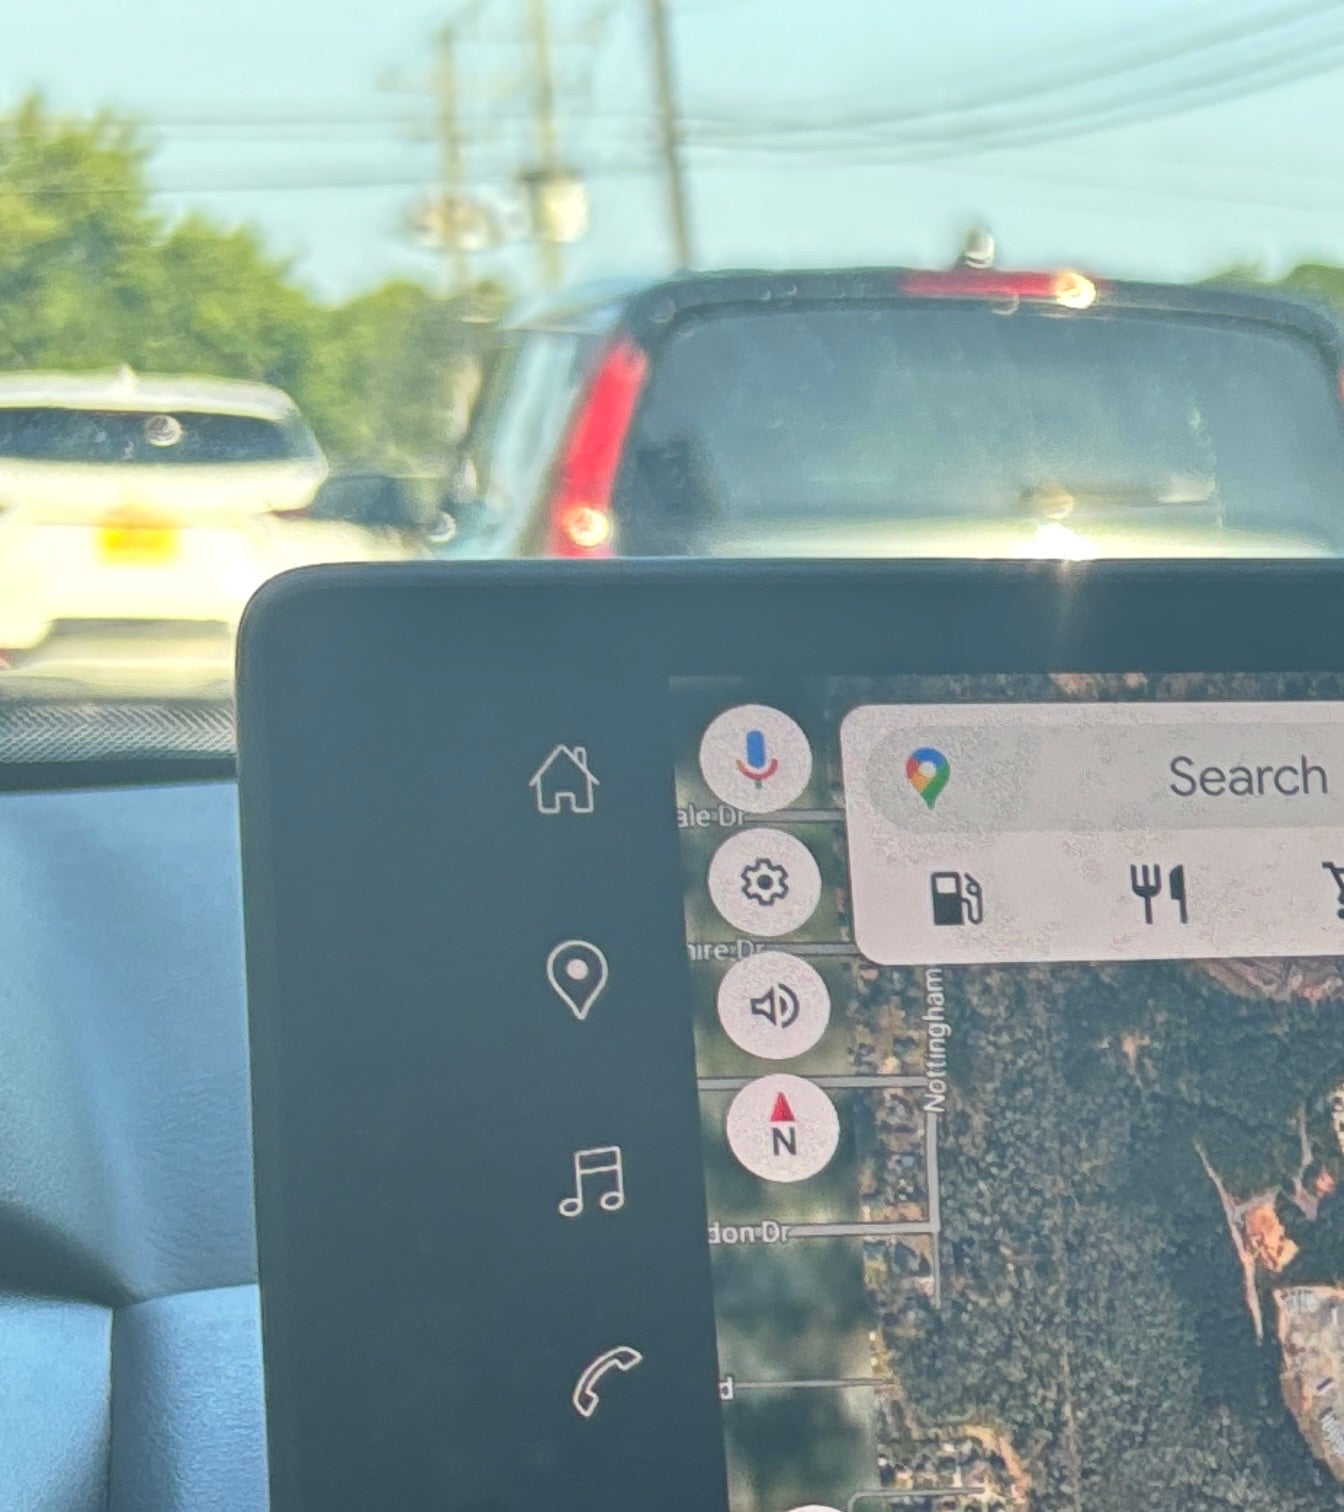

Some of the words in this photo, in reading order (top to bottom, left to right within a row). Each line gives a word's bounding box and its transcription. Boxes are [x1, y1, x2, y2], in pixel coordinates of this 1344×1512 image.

[1169, 755, 1328, 798] Search
[719, 804, 744, 827] Dr
[923, 967, 952, 1113] Nottingham
[773, 1128, 796, 1155] N
[762, 1221, 789, 1243] Dr
